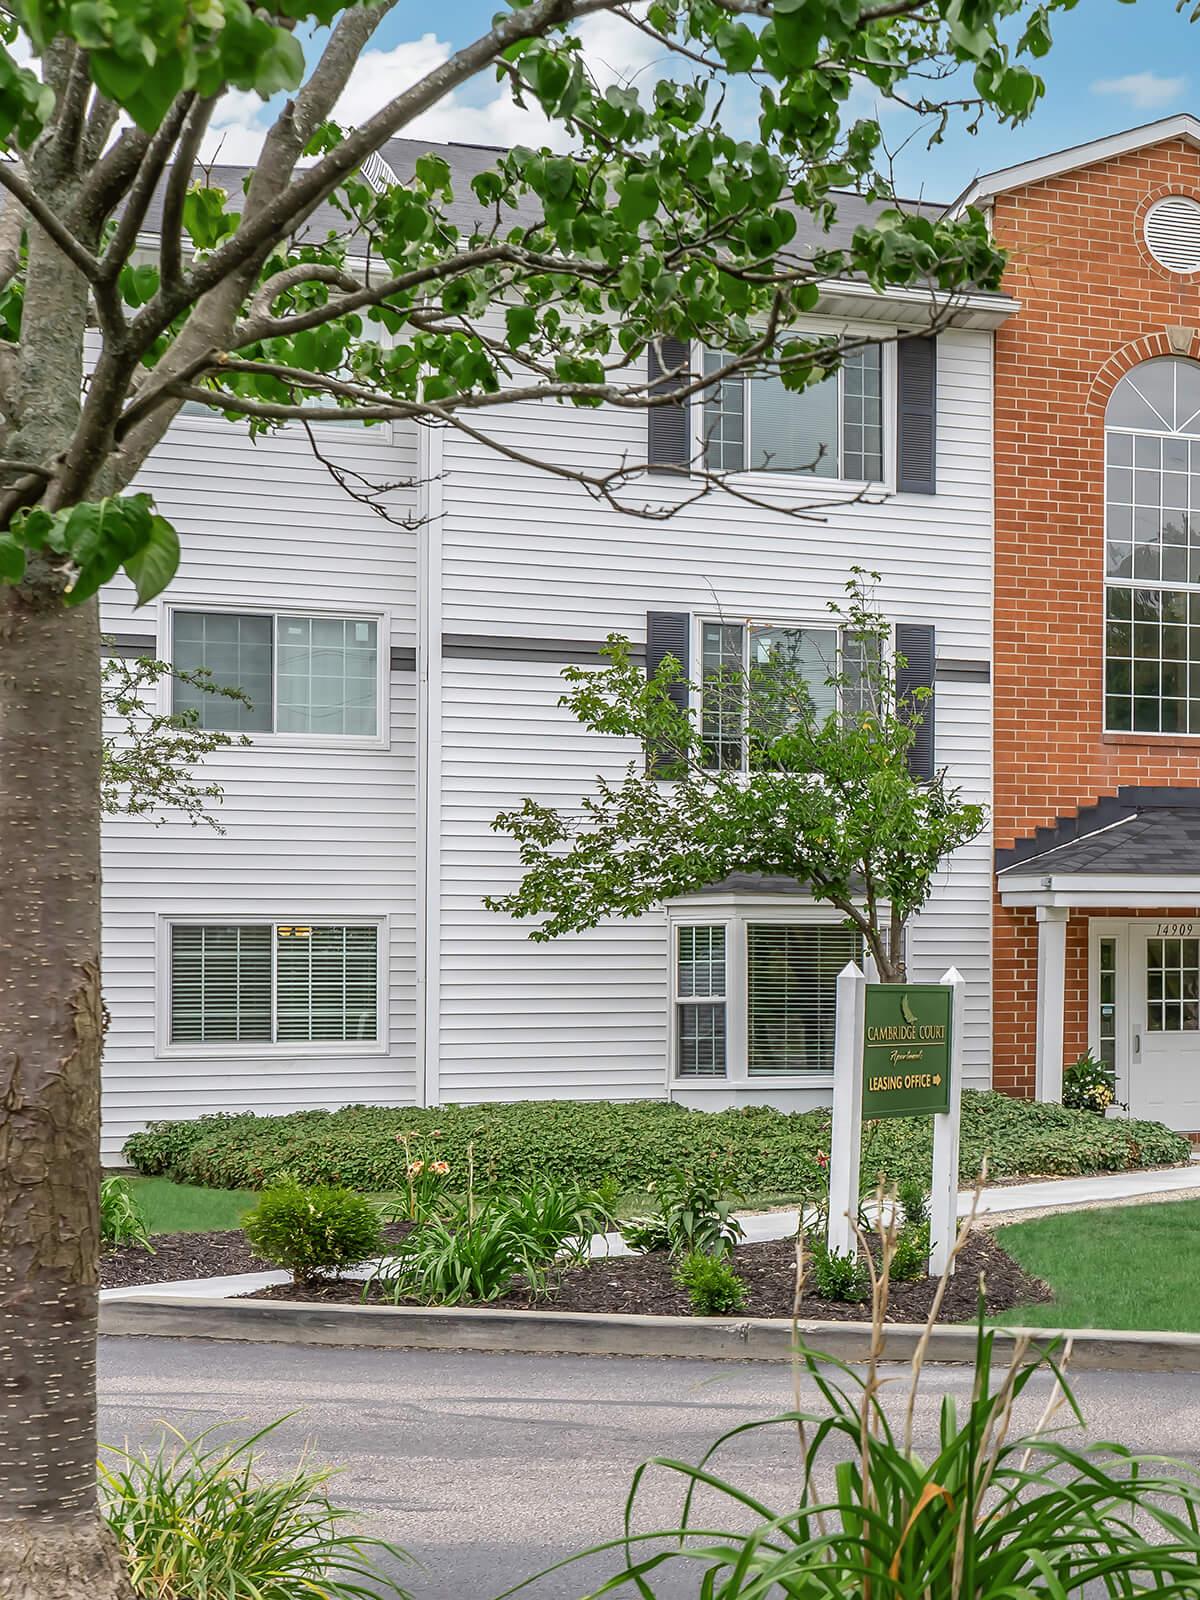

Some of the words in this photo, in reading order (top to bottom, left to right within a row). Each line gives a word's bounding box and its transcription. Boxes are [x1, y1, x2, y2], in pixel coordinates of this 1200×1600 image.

[1156, 923, 1193, 936] 14909
[867, 1025, 916, 1041] CAMBRIDGE
[919, 1025, 945, 1039] COURT
[869, 1075, 903, 1091] LEASING
[905, 1074, 931, 1089] OFFICE
